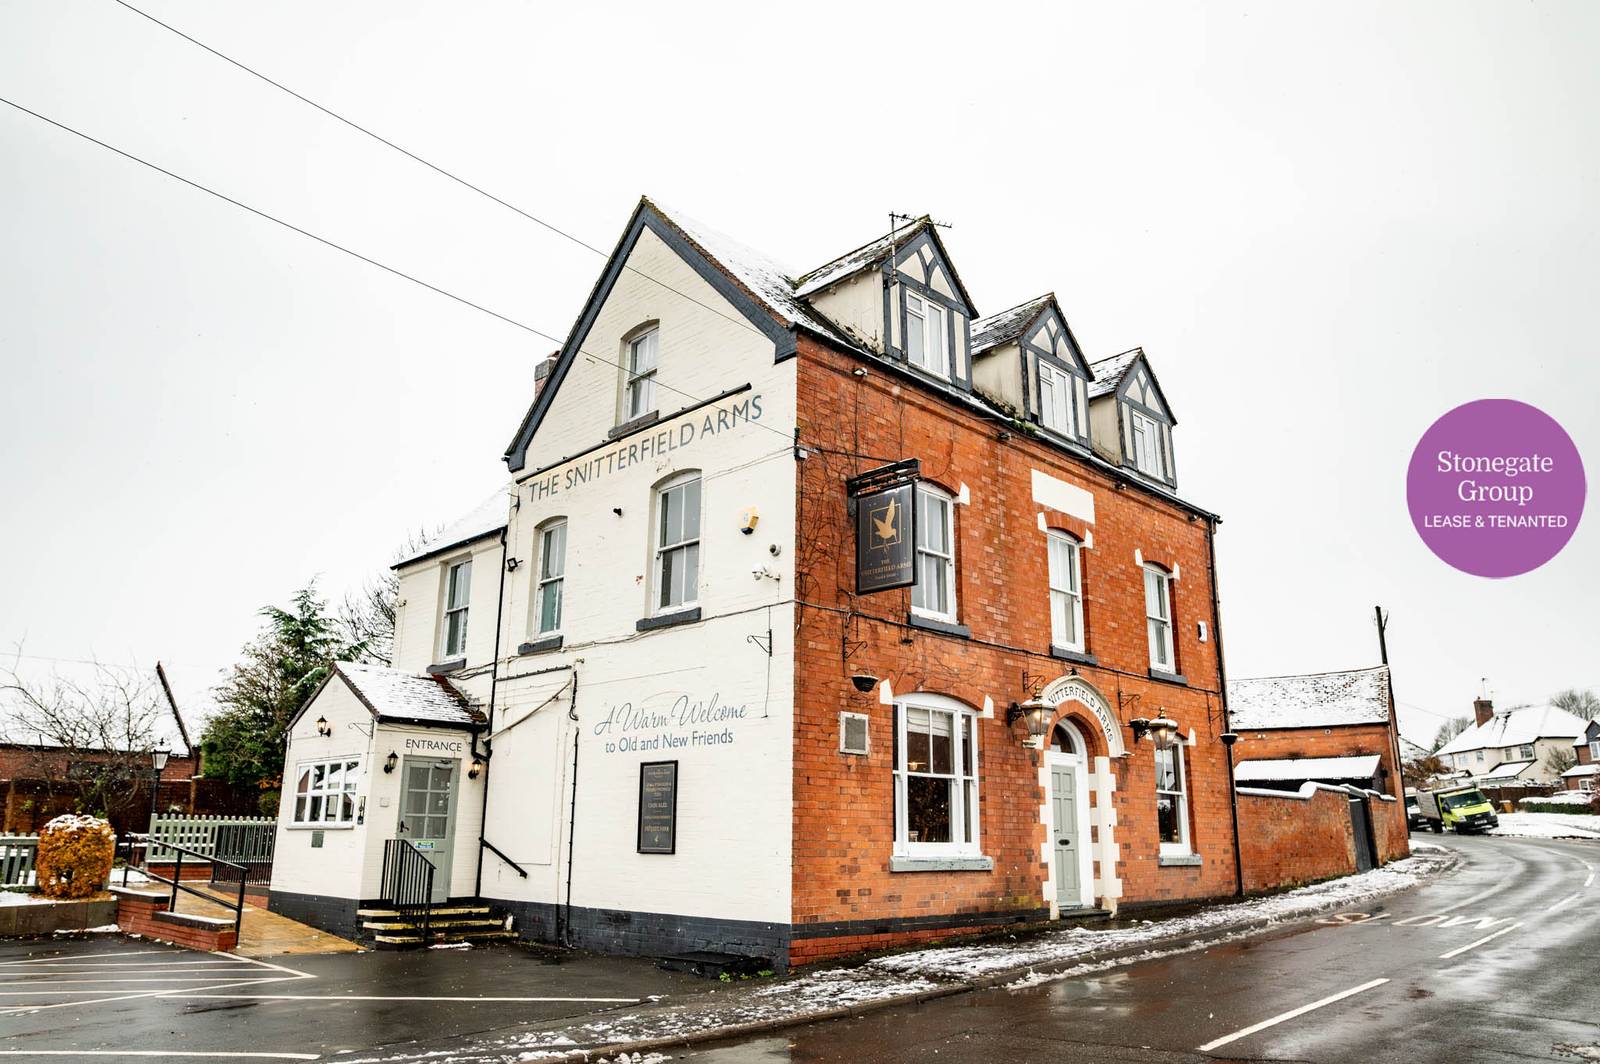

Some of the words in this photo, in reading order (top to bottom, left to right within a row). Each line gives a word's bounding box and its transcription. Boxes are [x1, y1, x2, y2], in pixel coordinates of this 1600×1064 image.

[529, 474, 560, 502] THE
[565, 422, 695, 490] SNITTERFIELD
[700, 395, 763, 440] ARMS
[594, 704, 616, 735] A
[616, 702, 669, 732] Warm
[671, 692, 747, 728] Welcome
[1096, 706, 1114, 742] ARMS
[406, 738, 462, 752] ENTRANCE
[605, 742, 616, 753] to
[619, 736, 638, 752] Old
[640, 734, 659, 751] and
[662, 734, 688, 749] New
[692, 728, 733, 747] Friends
[1314, 912, 1515, 929] SLOW
